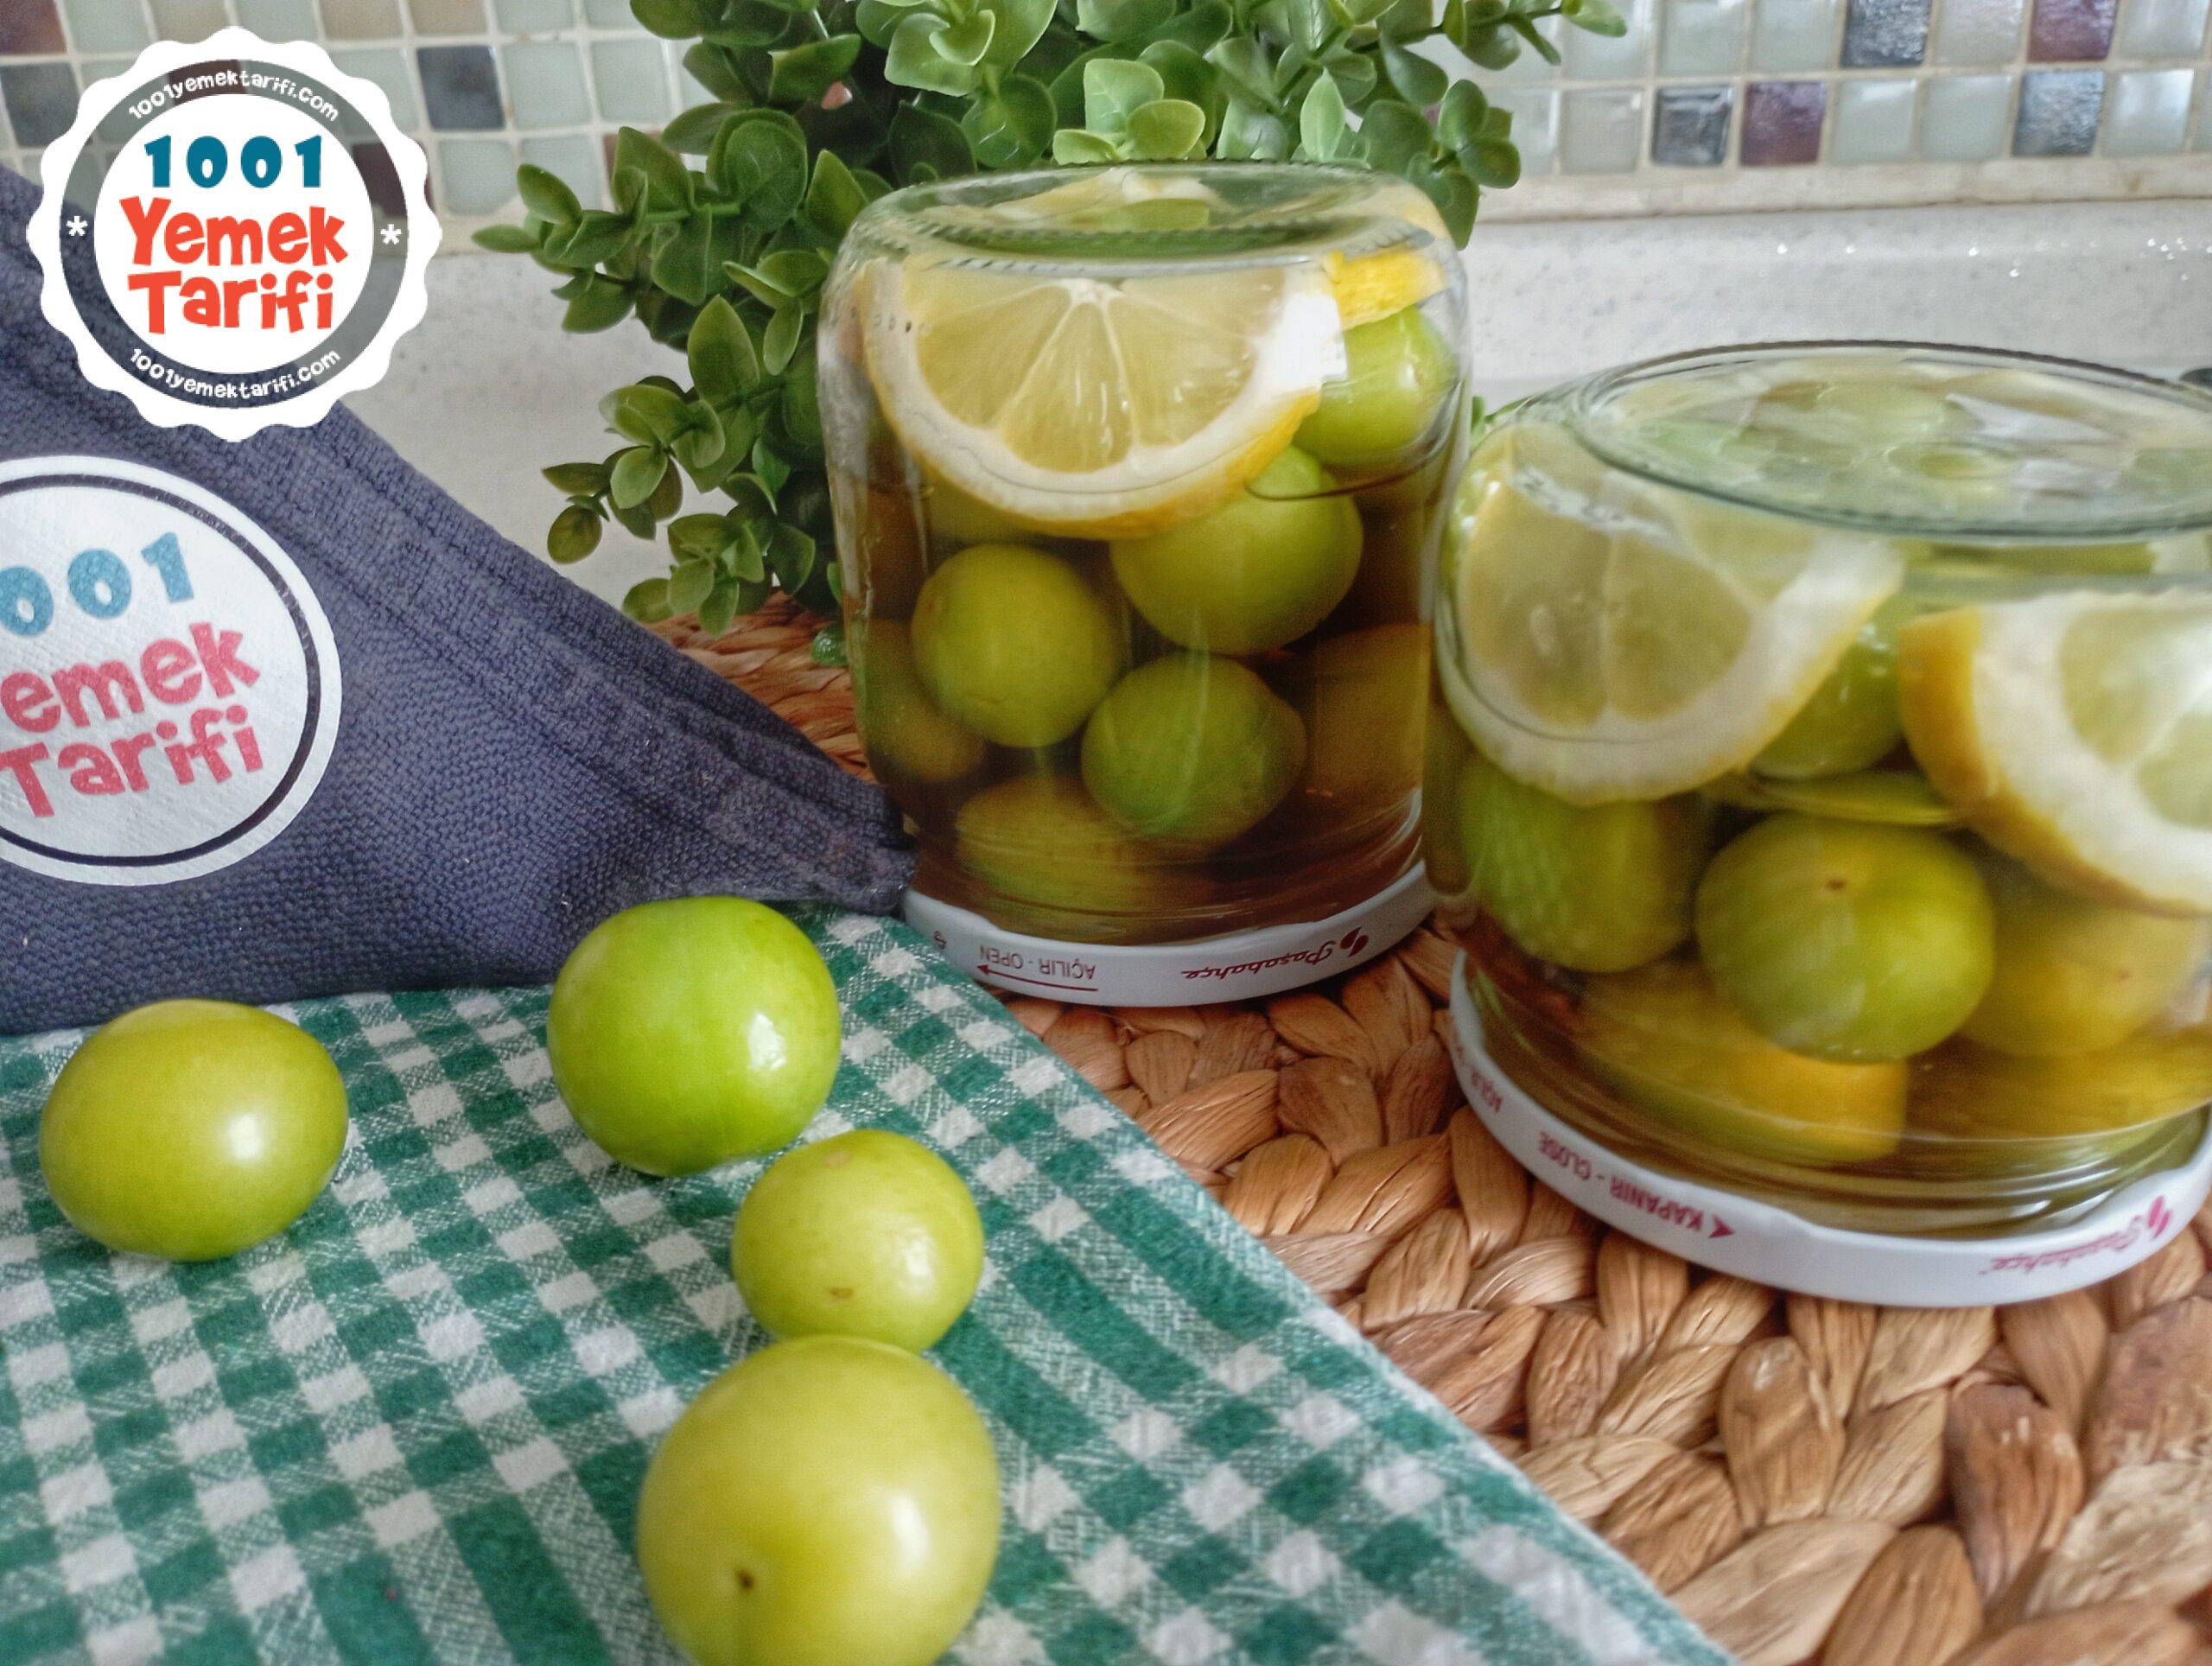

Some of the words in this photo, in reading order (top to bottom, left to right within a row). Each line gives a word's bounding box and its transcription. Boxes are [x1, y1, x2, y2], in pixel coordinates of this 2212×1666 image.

[0, 704, 264, 818] Tarifi
[979, 944, 1024, 970] OPEN
[1038, 958, 1096, 981] AÇILIR
